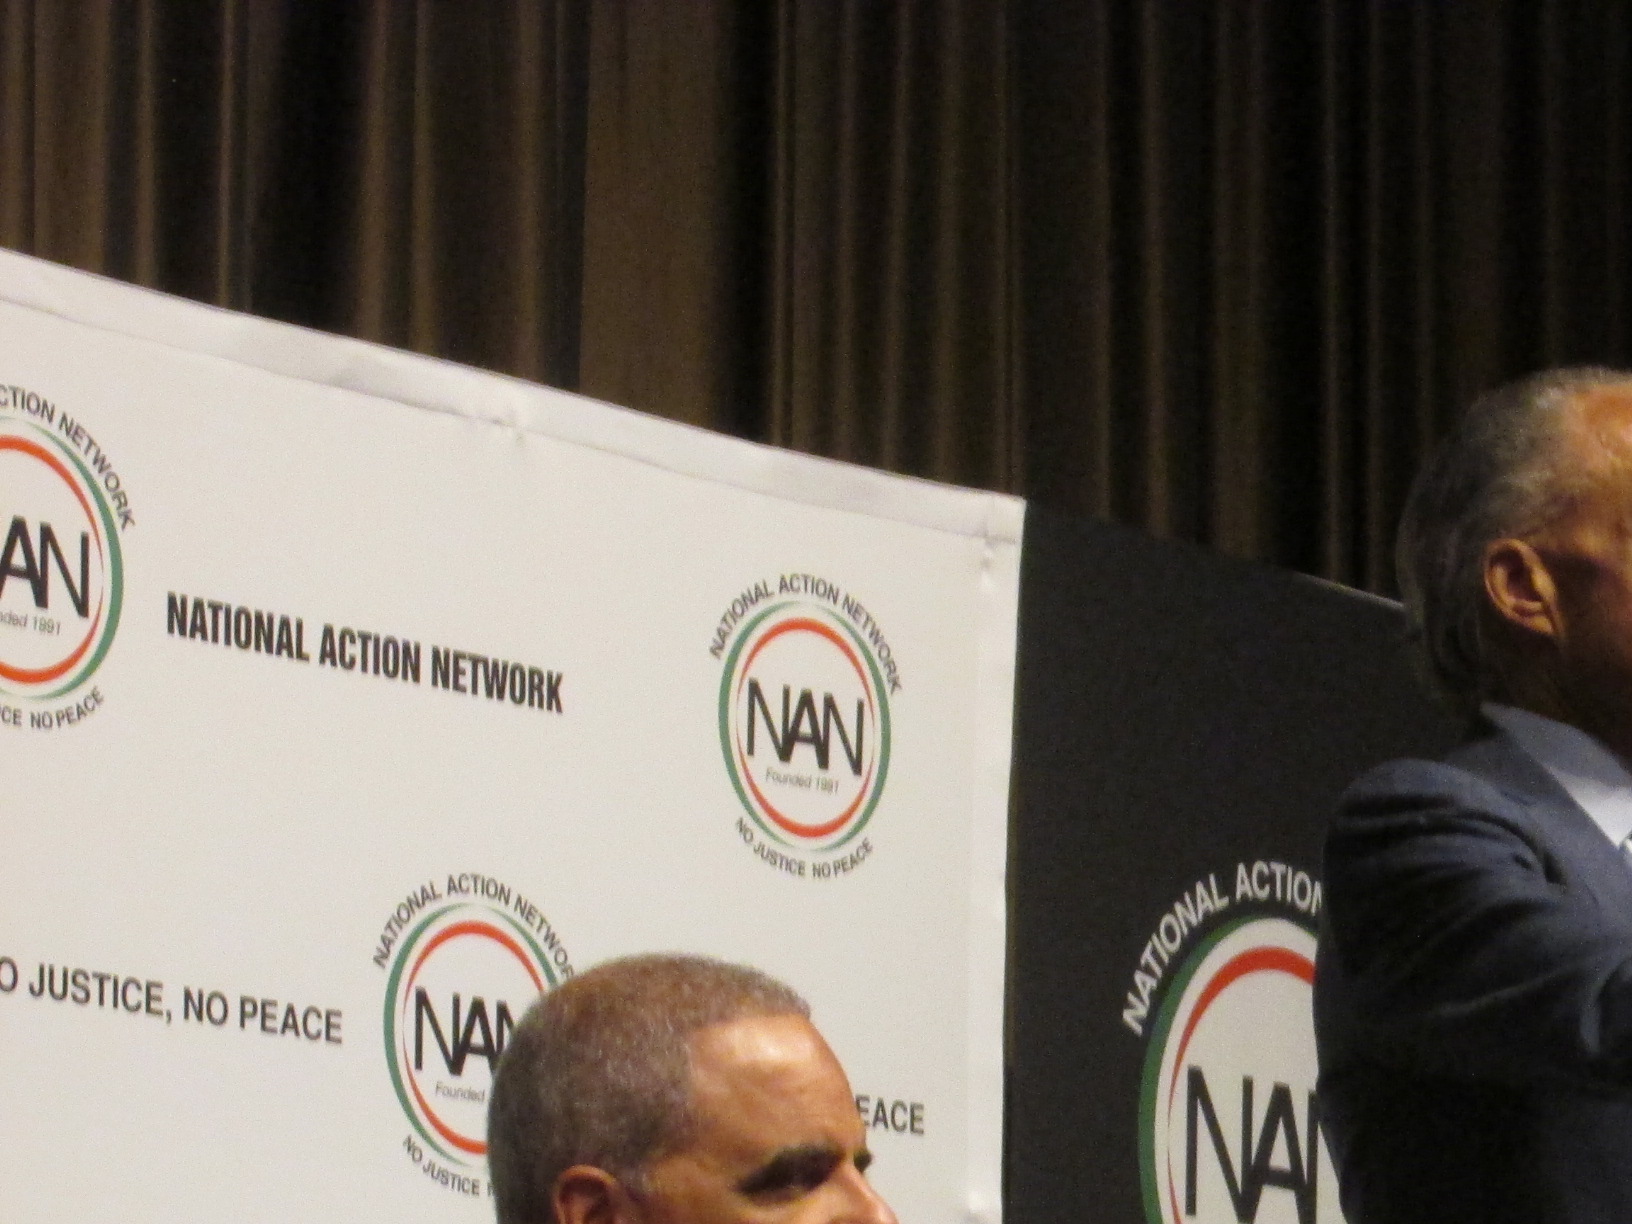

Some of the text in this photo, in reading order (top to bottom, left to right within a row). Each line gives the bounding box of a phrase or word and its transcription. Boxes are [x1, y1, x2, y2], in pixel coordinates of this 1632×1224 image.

[59, 411, 136, 532] NETWORK
[167, 591, 564, 715] NATIONAL ACTION NETWORK
[709, 573, 902, 695] NATIONAL ACTION NETWORK
[30, 711, 53, 728] NO
[56, 686, 104, 728] PEACE
[747, 676, 865, 778] NAN
[736, 817, 873, 878] NO JUSTICE NO PEACE
[373, 880, 443, 969] NATIONAL
[447, 872, 511, 906] ACTION
[1122, 872, 1230, 1037] NATIONAL
[29, 962, 172, 1024] JUSTICE,
[183, 985, 229, 1027] NO
[239, 994, 343, 1045] PEACE
[435, 1080, 486, 1103] Founded
[403, 1134, 423, 1163] NO
[423, 1160, 480, 1197] JUSTICE
